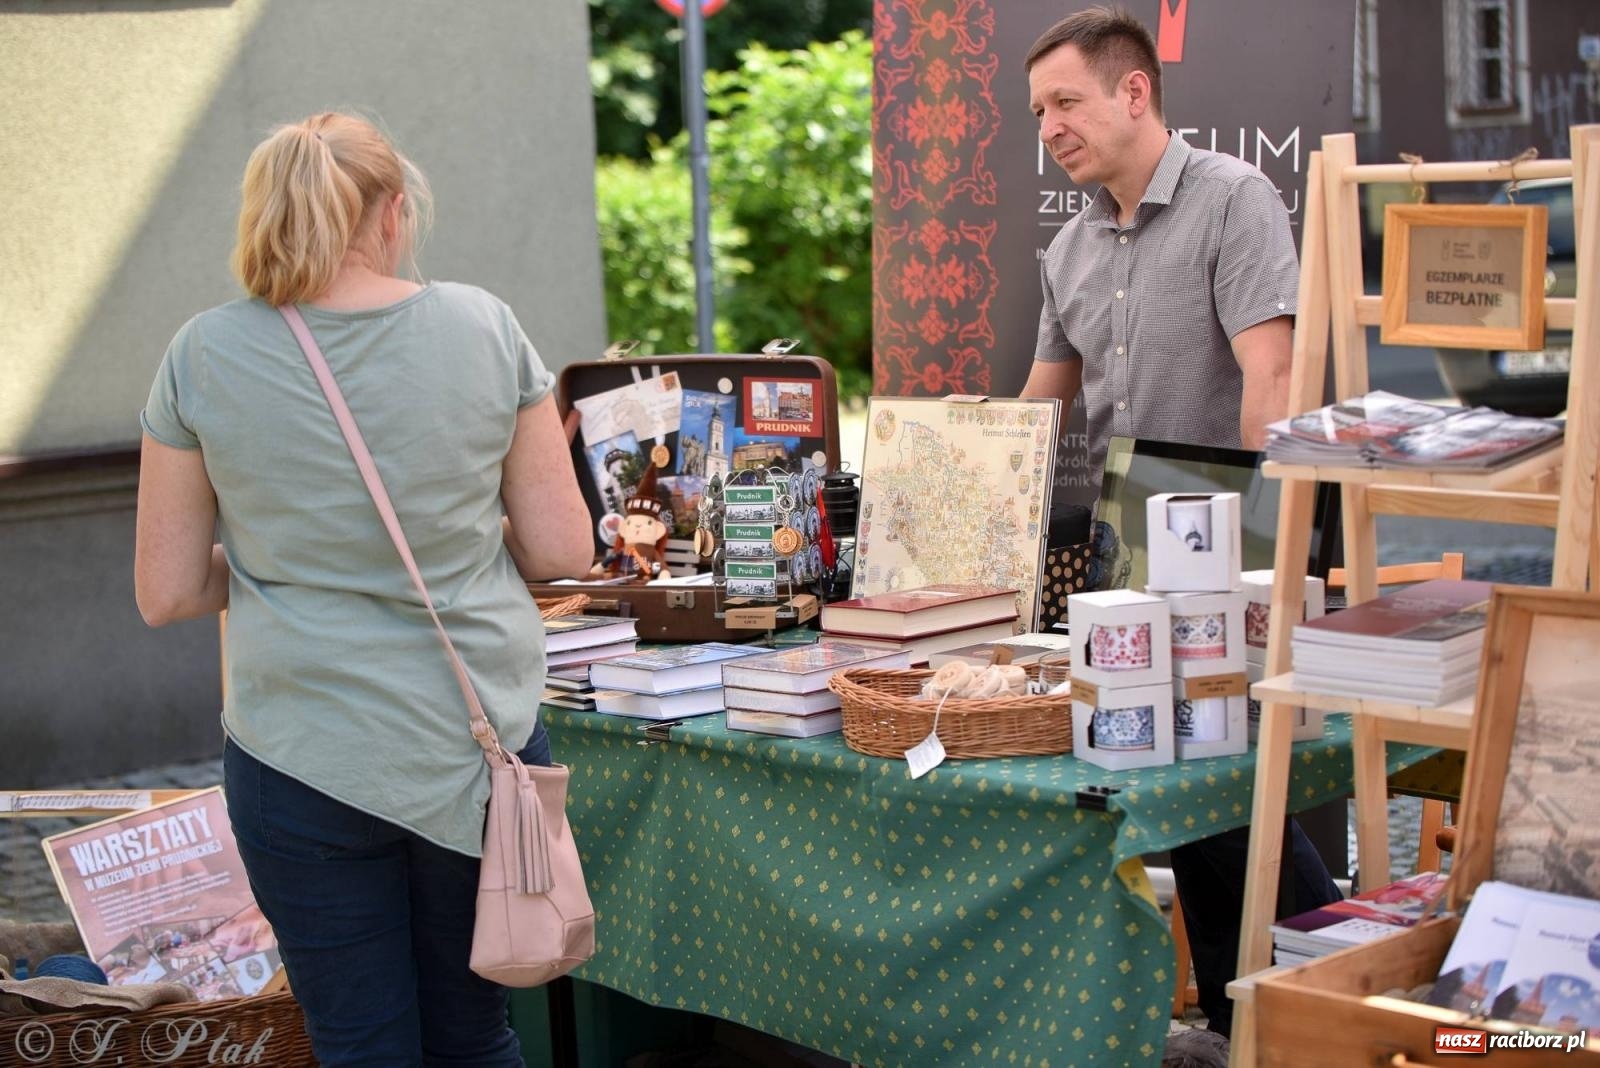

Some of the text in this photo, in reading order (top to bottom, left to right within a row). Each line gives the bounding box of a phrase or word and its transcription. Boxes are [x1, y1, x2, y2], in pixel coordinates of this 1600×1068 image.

[1426, 270, 1504, 285] EGZEMPLARZE
[1426, 290, 1503, 307] BEZPŁATNE
[756, 422, 811, 433] PRUDNIK
[736, 491, 762, 500] Prudnik
[736, 528, 761, 537] Prudnik
[738, 566, 763, 575] Prudnik
[70, 806, 213, 876] WARSZTATY
[84, 877, 95, 892] W
[94, 866, 135, 889] MUZEUM
